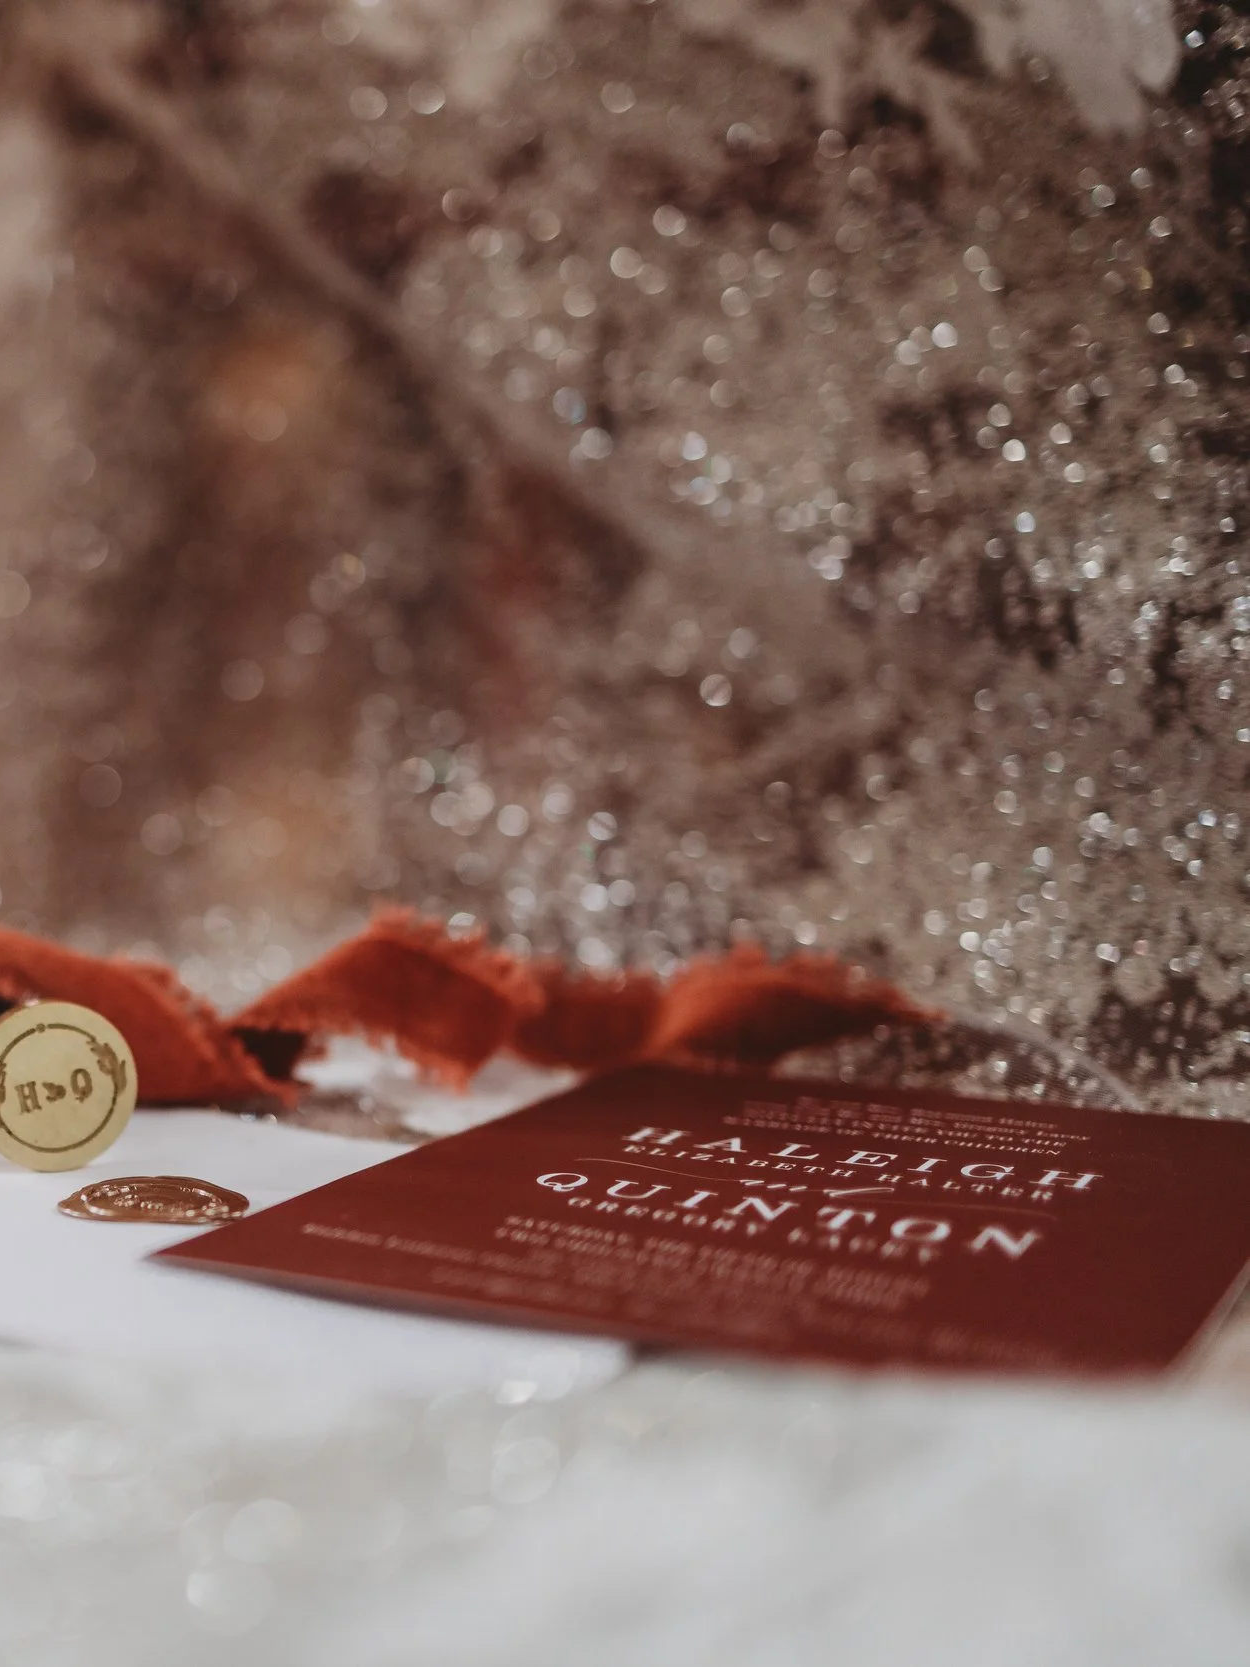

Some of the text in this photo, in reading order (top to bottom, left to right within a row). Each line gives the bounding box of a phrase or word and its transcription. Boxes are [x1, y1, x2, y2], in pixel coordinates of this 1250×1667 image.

[621, 1125, 1104, 1191] HALEIGH
[623, 1143, 1055, 1203] ELIZABETH HALTER
[536, 1171, 1042, 1260] QUINTON
